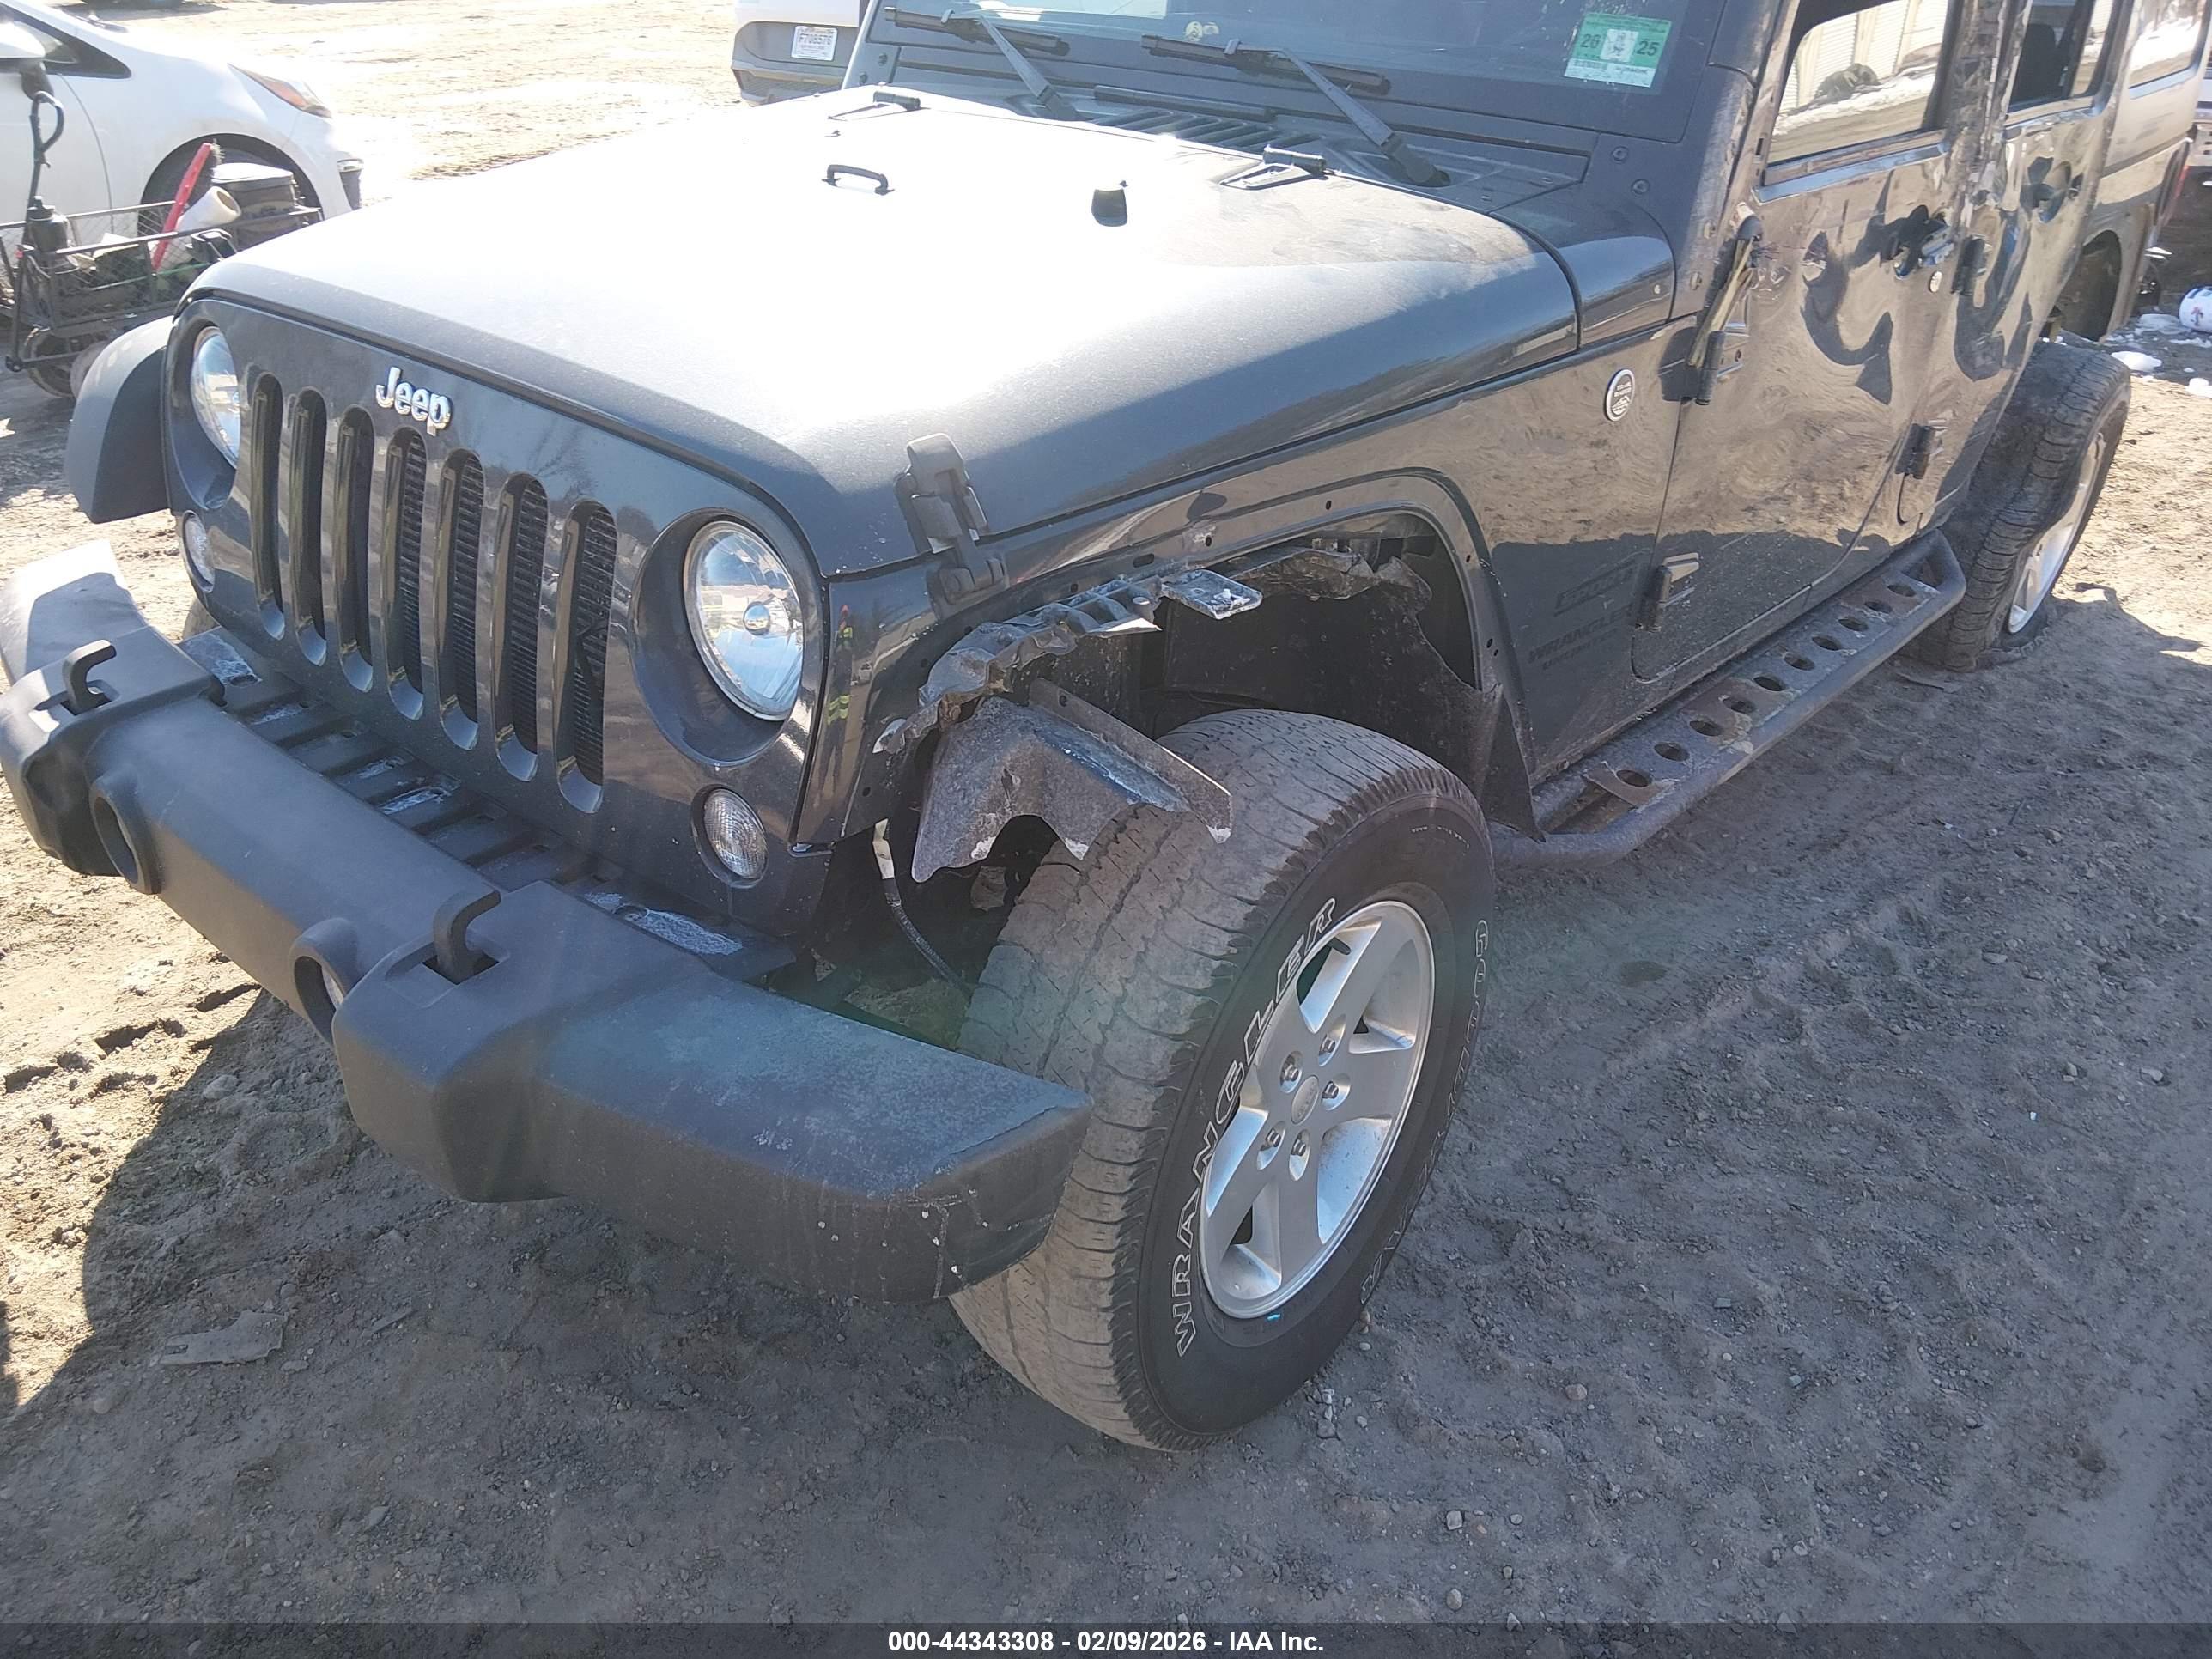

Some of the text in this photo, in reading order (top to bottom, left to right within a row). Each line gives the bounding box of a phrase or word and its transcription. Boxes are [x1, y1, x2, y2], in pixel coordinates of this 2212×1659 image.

[1635, 40, 1661, 57] 25
[375, 366, 451, 437] Jeep
[1171, 897, 1336, 1357] WRANGLER
